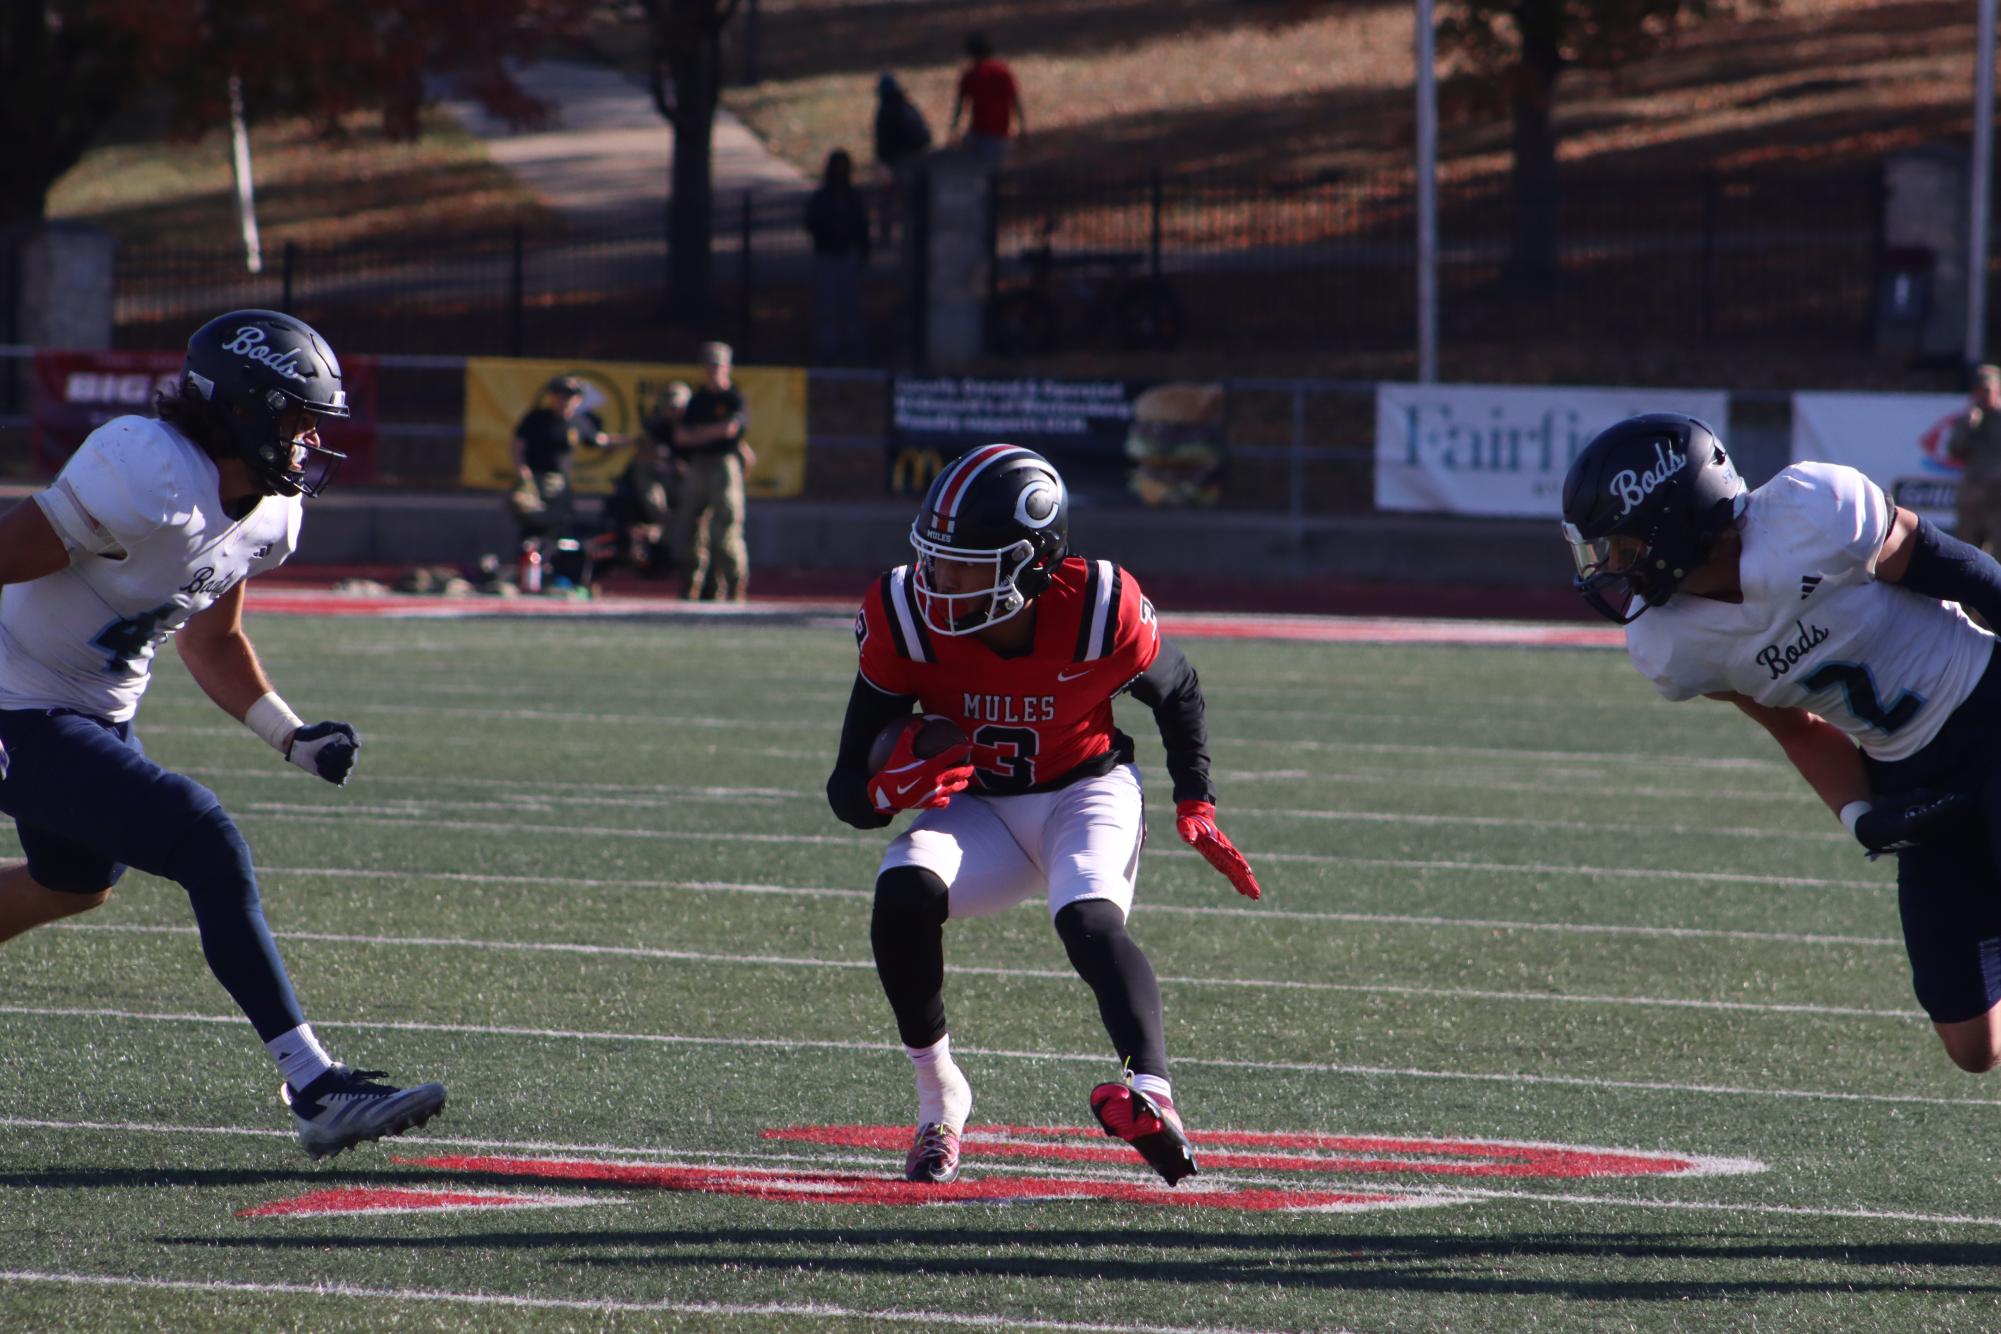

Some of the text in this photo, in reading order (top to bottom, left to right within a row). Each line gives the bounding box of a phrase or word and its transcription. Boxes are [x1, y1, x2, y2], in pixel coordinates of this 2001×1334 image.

[222, 326, 306, 383] Bods
[66, 372, 151, 403] BIG
[1404, 402, 1602, 473] Fairfi
[1609, 441, 1687, 516] Bods
[927, 529, 952, 543] MULES
[1756, 620, 1830, 681] Bods
[963, 691, 1056, 723] MULES
[1795, 660, 1928, 736] 2
[970, 724, 1041, 795] 3
